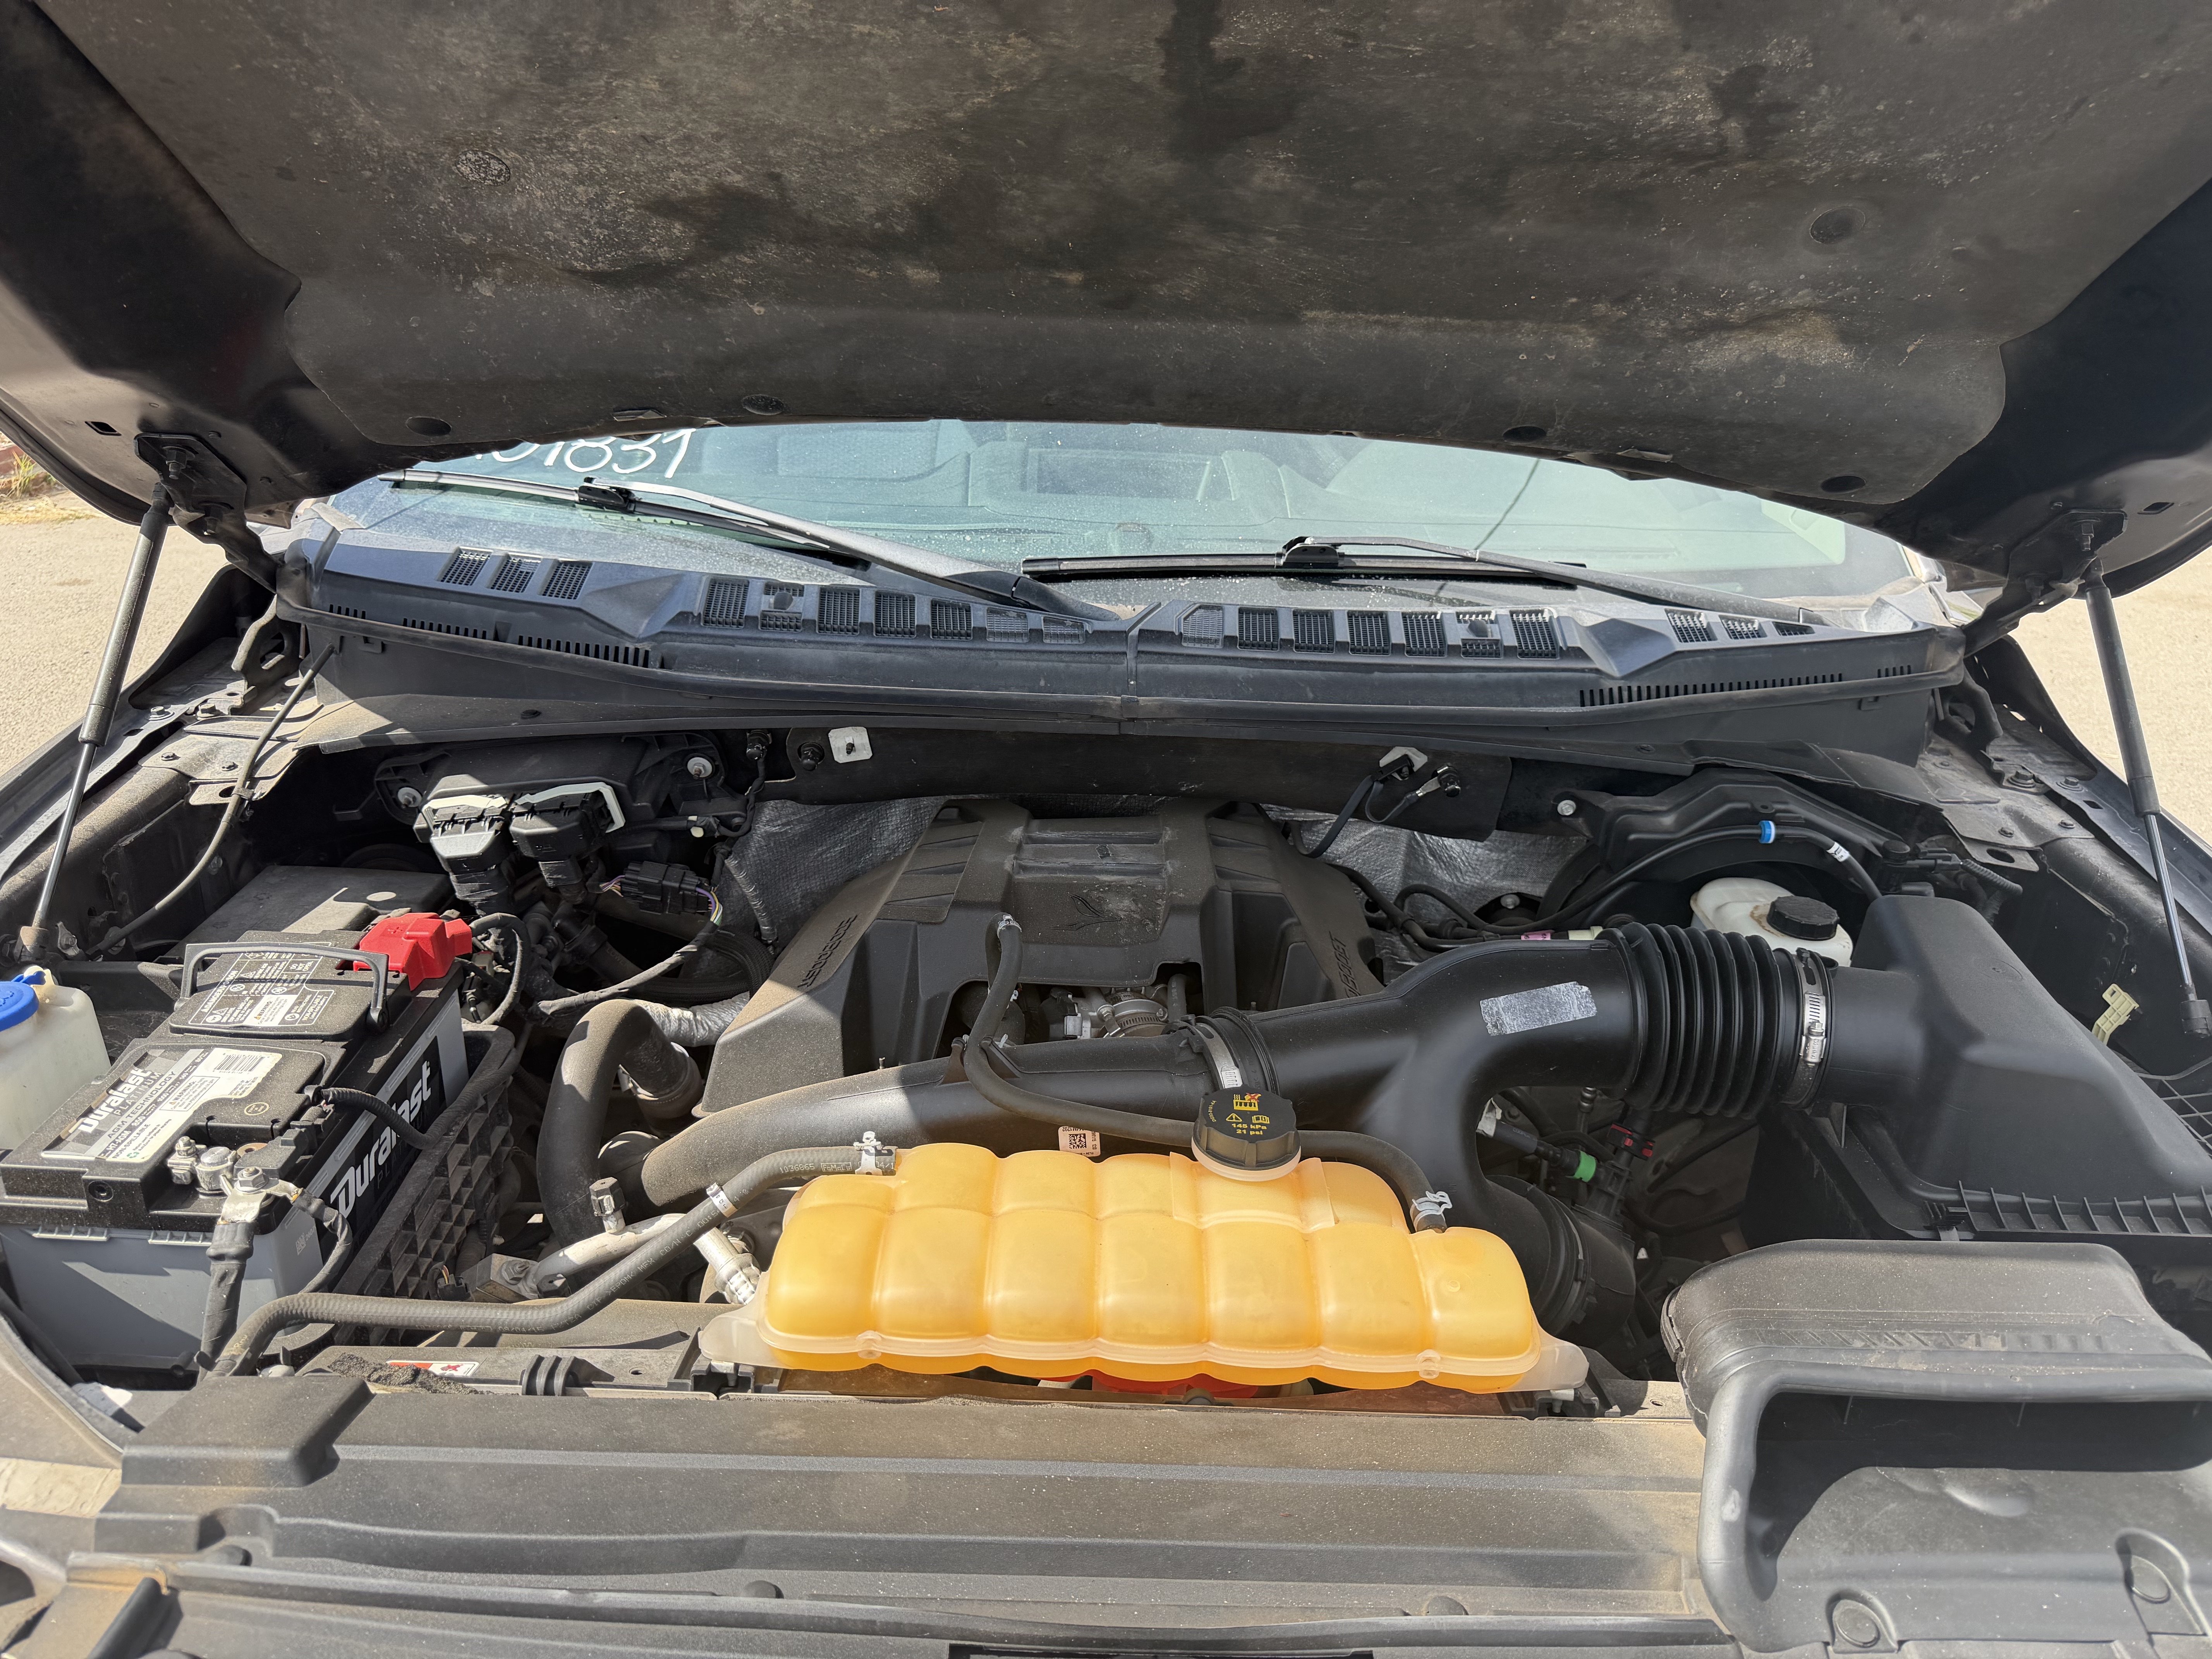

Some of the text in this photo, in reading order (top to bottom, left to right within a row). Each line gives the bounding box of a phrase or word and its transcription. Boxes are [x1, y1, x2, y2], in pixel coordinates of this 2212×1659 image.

[1329, 930, 1361, 998] BOOST
[69, 1068, 153, 1133] Duralast
[107, 1120, 128, 1139] AGM
[125, 1071, 177, 1119] TECHNOLOGY
[113, 1072, 162, 1116] PLATINUM
[106, 1130, 132, 1151] H7-AGM
[131, 1115, 146, 1127] 850
[780, 1163, 816, 1173] 1036865
[822, 1163, 852, 1172] FoMoCo
